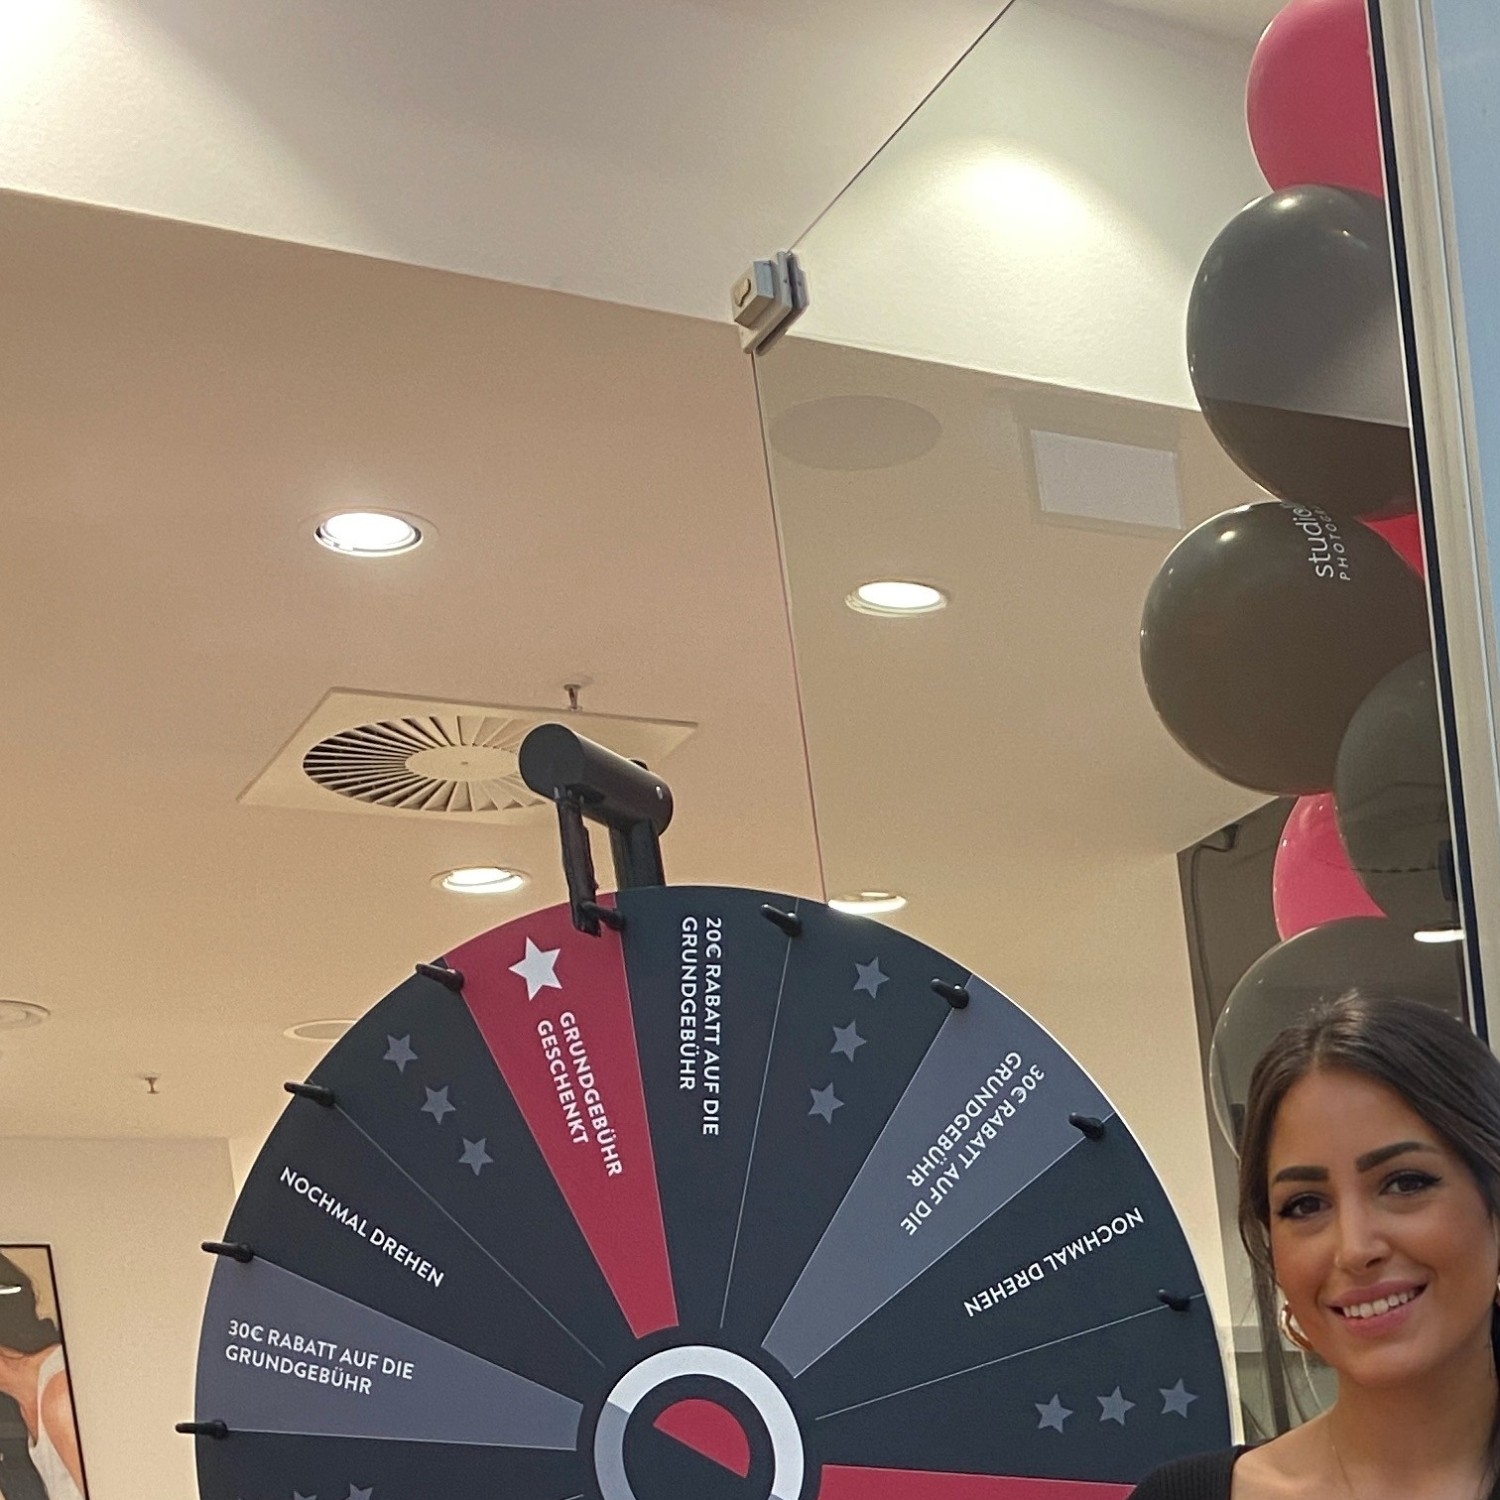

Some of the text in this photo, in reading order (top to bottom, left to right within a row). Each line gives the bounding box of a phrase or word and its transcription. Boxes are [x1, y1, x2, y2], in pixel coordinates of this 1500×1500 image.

[679, 916, 700, 1090] GRUNDGEBÜHR
[704, 964, 721, 1046] RABATT
[537, 1020, 589, 1143] GESCHENKT
[560, 1011, 623, 1177] GRUNDGEBÜHR
[703, 1049, 720, 1094] AUF
[702, 1099, 719, 1136] DIE
[906, 1052, 1022, 1187] GRUNDGEBÜHR
[958, 1099, 1016, 1169] RABATT
[900, 1200, 933, 1236] DIE
[930, 1162, 960, 1205] AUF
[280, 1166, 444, 1287] NOCHMAL DREHEN
[963, 1207, 1144, 1317] NOCHMAL DREHEN
[225, 1344, 372, 1395] GRUNDGEBÜHR
[267, 1329, 338, 1360] RABATT
[339, 1348, 379, 1370] AUF
[381, 1357, 415, 1380] DIE
